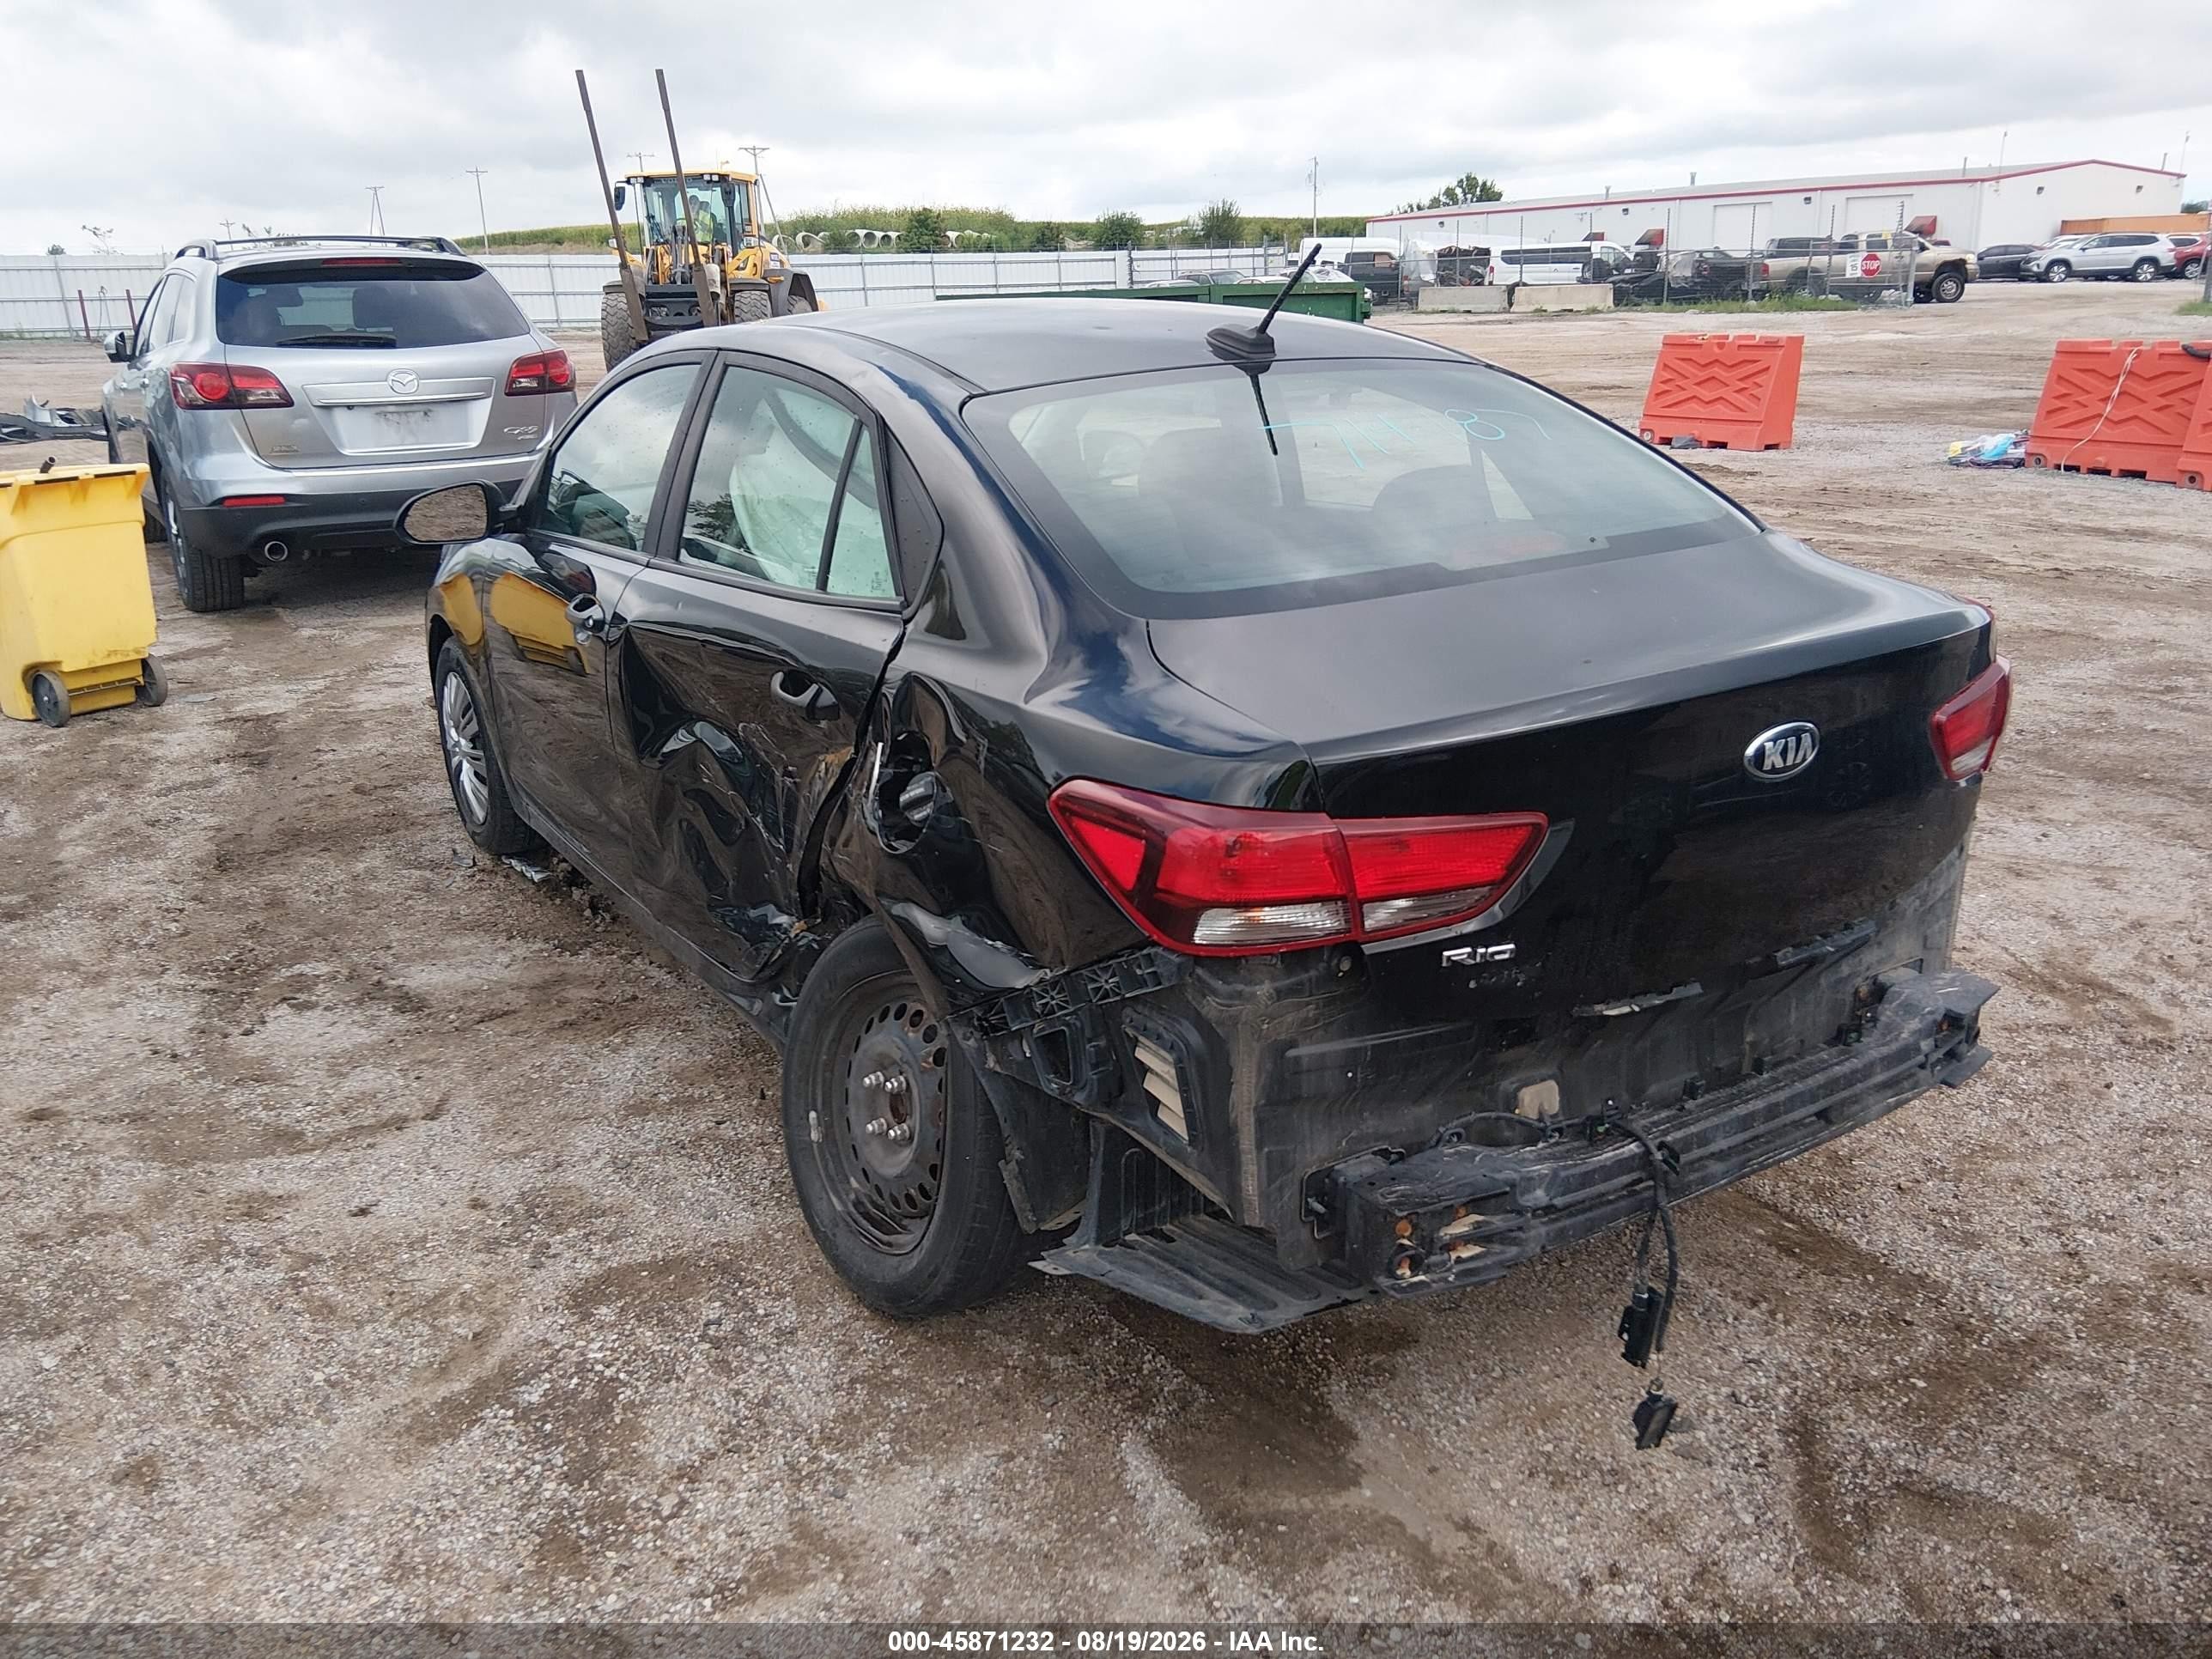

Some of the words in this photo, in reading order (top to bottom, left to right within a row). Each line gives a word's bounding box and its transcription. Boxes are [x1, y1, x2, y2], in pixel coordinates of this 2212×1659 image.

[1861, 259, 1881, 271] STOP
[1761, 732, 1814, 771] KIA
[1441, 943, 1516, 967] RIO
